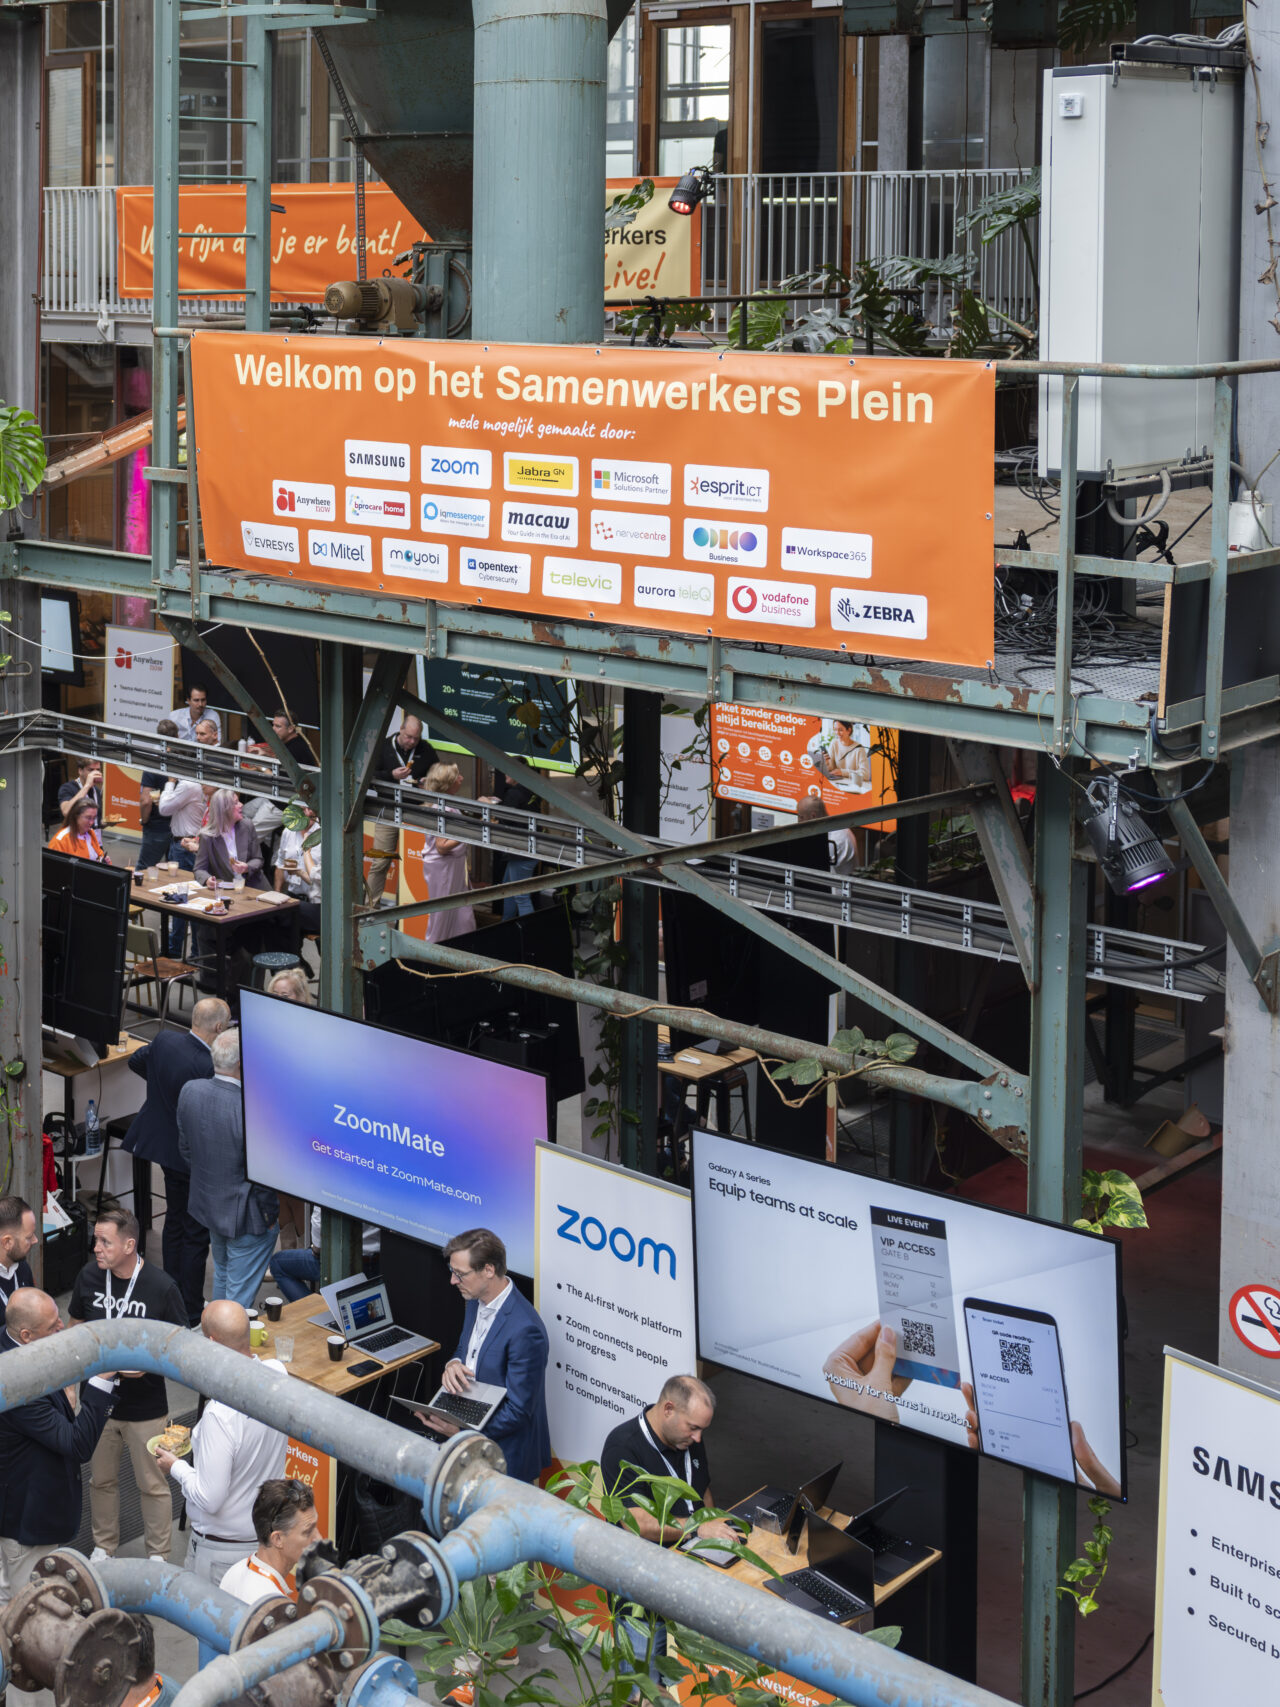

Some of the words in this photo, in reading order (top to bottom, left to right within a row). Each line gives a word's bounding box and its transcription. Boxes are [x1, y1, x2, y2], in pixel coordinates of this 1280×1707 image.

[273, 227, 295, 264] je
[304, 232, 328, 254] er
[234, 353, 362, 391] Welkom
[374, 366, 416, 401] op
[428, 360, 484, 399] het
[496, 365, 801, 417] Samenwerkers
[818, 379, 934, 424] Plein
[448, 414, 479, 429] mede
[482, 417, 534, 438] mogelijk
[537, 421, 596, 439] gemaakt
[600, 421, 636, 440] door:
[349, 452, 406, 468] SAMSUNG
[430, 458, 480, 475] zoom
[517, 466, 551, 477] Jabra
[552, 468, 565, 476] GN
[614, 471, 659, 485] Microsoft
[613, 483, 643, 494] Solutions
[644, 486, 669, 496] Partner
[296, 496, 331, 507] Anywhere
[315, 505, 331, 513] now
[384, 503, 405, 514] home
[439, 509, 485, 522] iqmessenger
[508, 511, 570, 529] macaw
[519, 530, 535, 538] Guide
[615, 529, 667, 542] nervecentre
[254, 537, 295, 552] EVRESYS
[330, 543, 365, 561] Mitel
[390, 549, 440, 565] moyobi
[709, 552, 739, 563] Business
[797, 546, 867, 561] Workspace365
[478, 557, 518, 574] opentext
[478, 573, 518, 585] Cybersecurity
[549, 571, 612, 590] televic
[637, 584, 676, 598] aurora
[678, 585, 711, 602] teleQ
[762, 591, 809, 606] vodafone
[761, 602, 801, 617] business
[863, 604, 916, 623] ZEBRA
[133, 655, 163, 666] Anywhere
[442, 685, 455, 694] 20+
[443, 707, 459, 717] 96%
[716, 702, 739, 714] Piket
[740, 707, 773, 720] zonder
[774, 713, 807, 726] gedoe:
[716, 713, 740, 727] altijd
[741, 716, 796, 736] bereikbaar!
[664, 816, 685, 825] control
[333, 1104, 445, 1158] ZoomMate
[311, 1140, 332, 1156] Get
[333, 1148, 375, 1170] started
[376, 1162, 390, 1175] at
[390, 1166, 483, 1206] ZoomMate.com
[708, 1162, 737, 1179] Galaxy
[738, 1171, 745, 1179] A
[745, 1172, 772, 1186] Series
[709, 1178, 746, 1201] Equip
[749, 1189, 796, 1214] teams
[798, 1205, 815, 1219] at
[818, 1210, 858, 1231] scale
[887, 1214, 903, 1225] LIVE
[904, 1217, 929, 1230] EVENT
[556, 1203, 677, 1281] zoom
[880, 1236, 896, 1248] VIP
[897, 1240, 936, 1257] ACCESS
[881, 1248, 902, 1260] GATE
[903, 1252, 910, 1261] B
[92, 1291, 147, 1318] zoom
[566, 1283, 583, 1298] The
[584, 1291, 615, 1312] AI-first
[617, 1305, 639, 1322] work
[641, 1316, 683, 1339] platform
[565, 1315, 591, 1334] Zoom
[592, 1329, 634, 1353] connects
[636, 1348, 669, 1368] people
[565, 1332, 575, 1344] to
[576, 1339, 617, 1362] progress
[565, 1364, 588, 1382] From
[590, 1376, 648, 1408] conversation
[989, 1374, 1010, 1384] ACCESS
[565, 1381, 574, 1392] to
[576, 1387, 625, 1415] completion
[824, 1372, 865, 1395] Mobility
[865, 1383, 881, 1398] for
[882, 1391, 919, 1412] teams
[919, 1403, 930, 1415] in
[931, 1407, 973, 1429] motion.
[284, 1457, 319, 1488] Live!
[1210, 1575, 1244, 1601] Built
[1246, 1592, 1261, 1609] to
[1208, 1614, 1267, 1653] Secured
